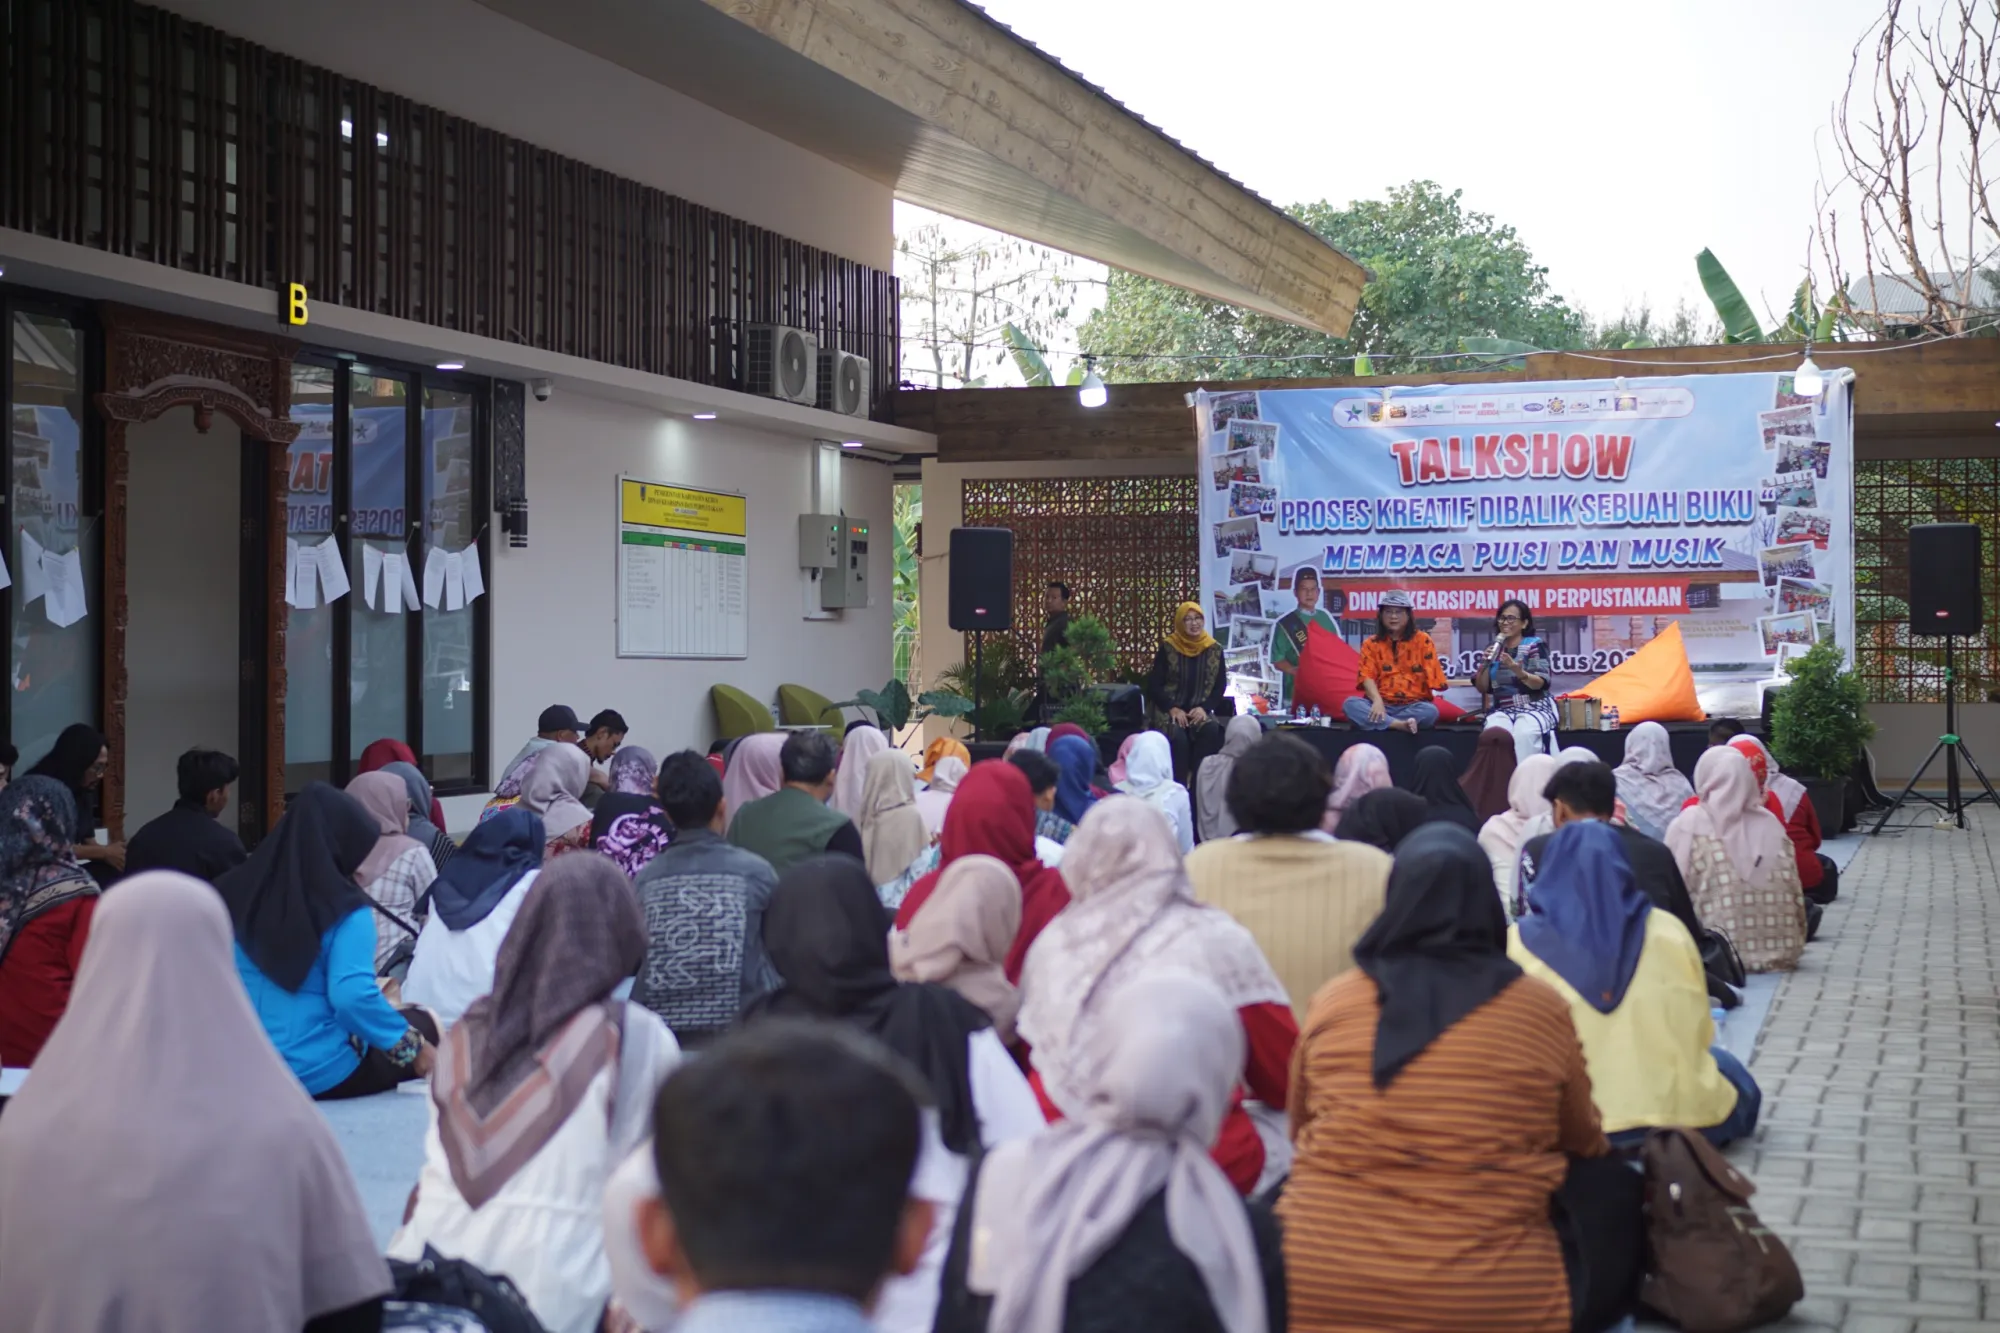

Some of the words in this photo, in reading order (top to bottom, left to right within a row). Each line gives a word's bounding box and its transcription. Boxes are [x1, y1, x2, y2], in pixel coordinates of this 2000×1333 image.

[290, 282, 308, 325] B
[1391, 432, 1633, 485] TALKSHOW
[1280, 498, 1371, 531] PROSES
[1377, 496, 1474, 530] KREATIF
[1480, 493, 1575, 528] DIBALIK
[1581, 490, 1678, 525] SEBUAH
[1686, 488, 1754, 522] BUKU
[1323, 542, 1463, 571] MEMBACA
[1474, 541, 1548, 569] PUISI
[1558, 539, 1620, 567] DAN
[1629, 537, 1724, 566] MUSIK
[1405, 589, 1499, 611] KEARSIPAN
[1504, 588, 1540, 609] DAN
[1546, 586, 1682, 609] PERPUSTAKAAN
[1594, 650, 1637, 672] 20
